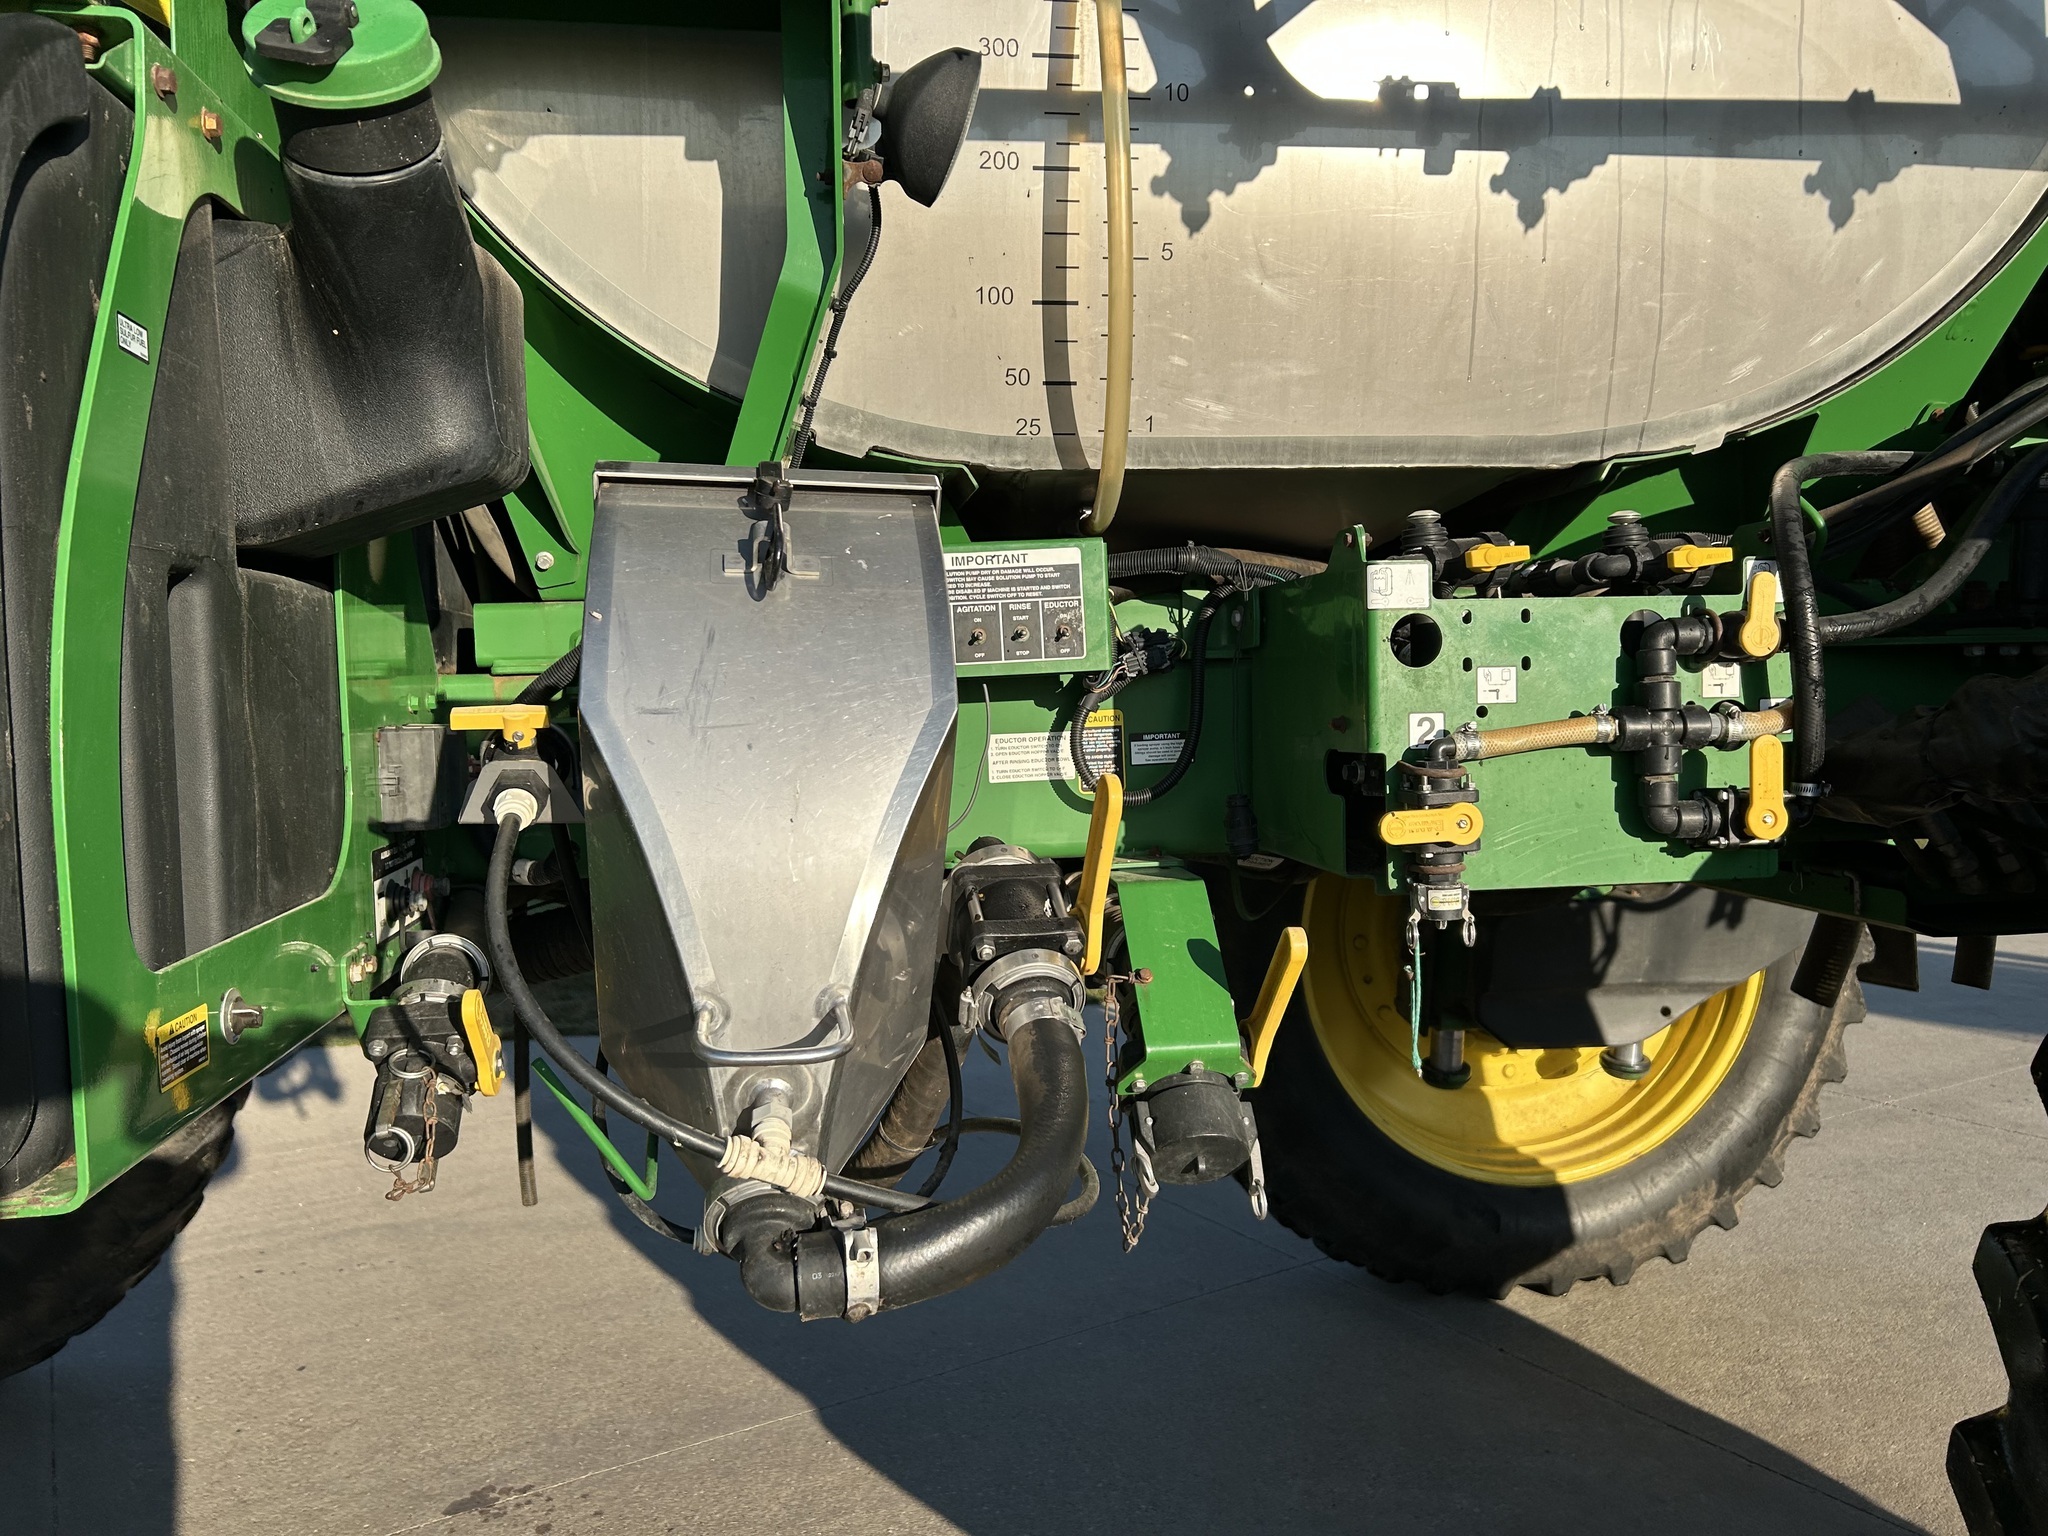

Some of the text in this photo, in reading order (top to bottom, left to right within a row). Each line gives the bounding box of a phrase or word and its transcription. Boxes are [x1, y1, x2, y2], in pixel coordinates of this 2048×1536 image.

[978, 37, 1019, 57] 300
[1164, 83, 1189, 102] 10
[978, 150, 1020, 170] 200
[1161, 242, 1173, 260] 5
[976, 286, 1014, 305] 100
[1004, 368, 1031, 386] 50
[1016, 418, 1042, 436] 25
[1145, 416, 1154, 433] 1
[951, 553, 1028, 566] IMPORTANT
[956, 604, 996, 613] AGITATION
[1044, 600, 1078, 608] EDUCTOR
[1088, 714, 1120, 723] CAUTION
[1416, 716, 1436, 744] 2
[174, 1012, 198, 1032] CAUTION
